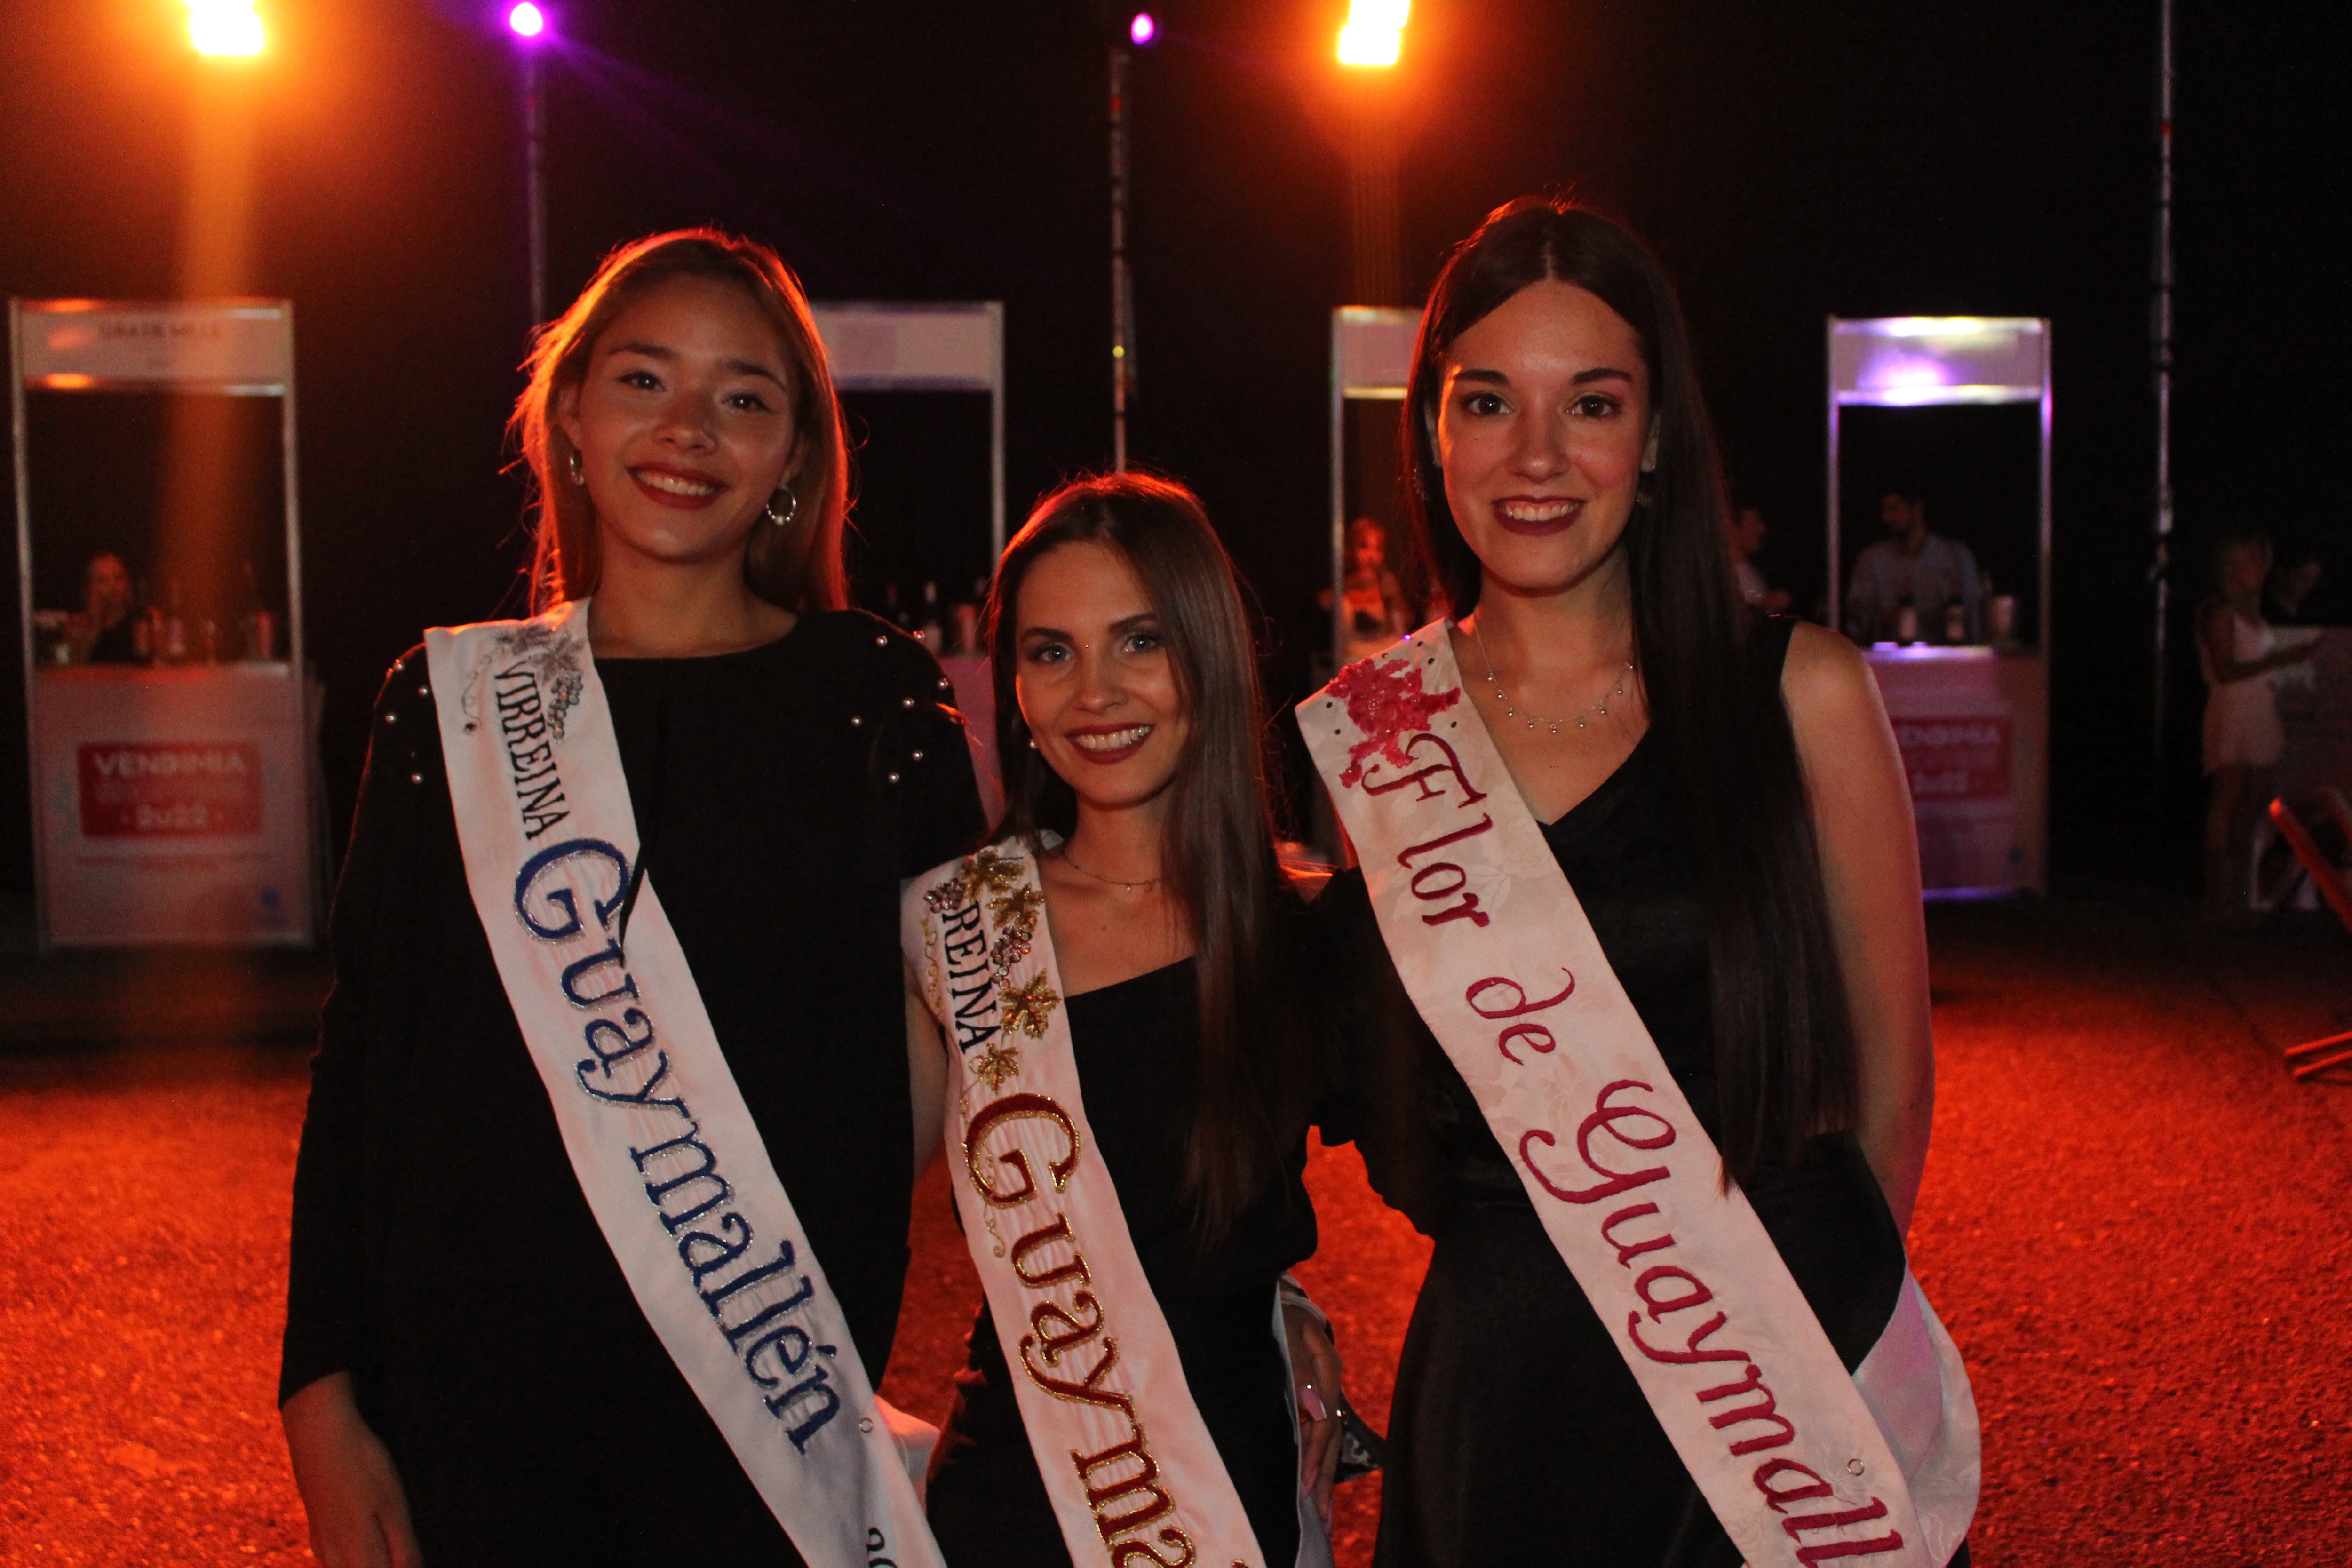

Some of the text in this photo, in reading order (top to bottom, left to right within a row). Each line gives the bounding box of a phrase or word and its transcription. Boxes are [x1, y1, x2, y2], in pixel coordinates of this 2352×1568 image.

[93, 750, 247, 777] VENDIMIA
[1361, 732, 1493, 928] Flor
[1465, 967, 1576, 1066] de
[494, 660, 841, 1456] VIRREINA Guaymallén
[941, 903, 1249, 1568] REINA Guayma
